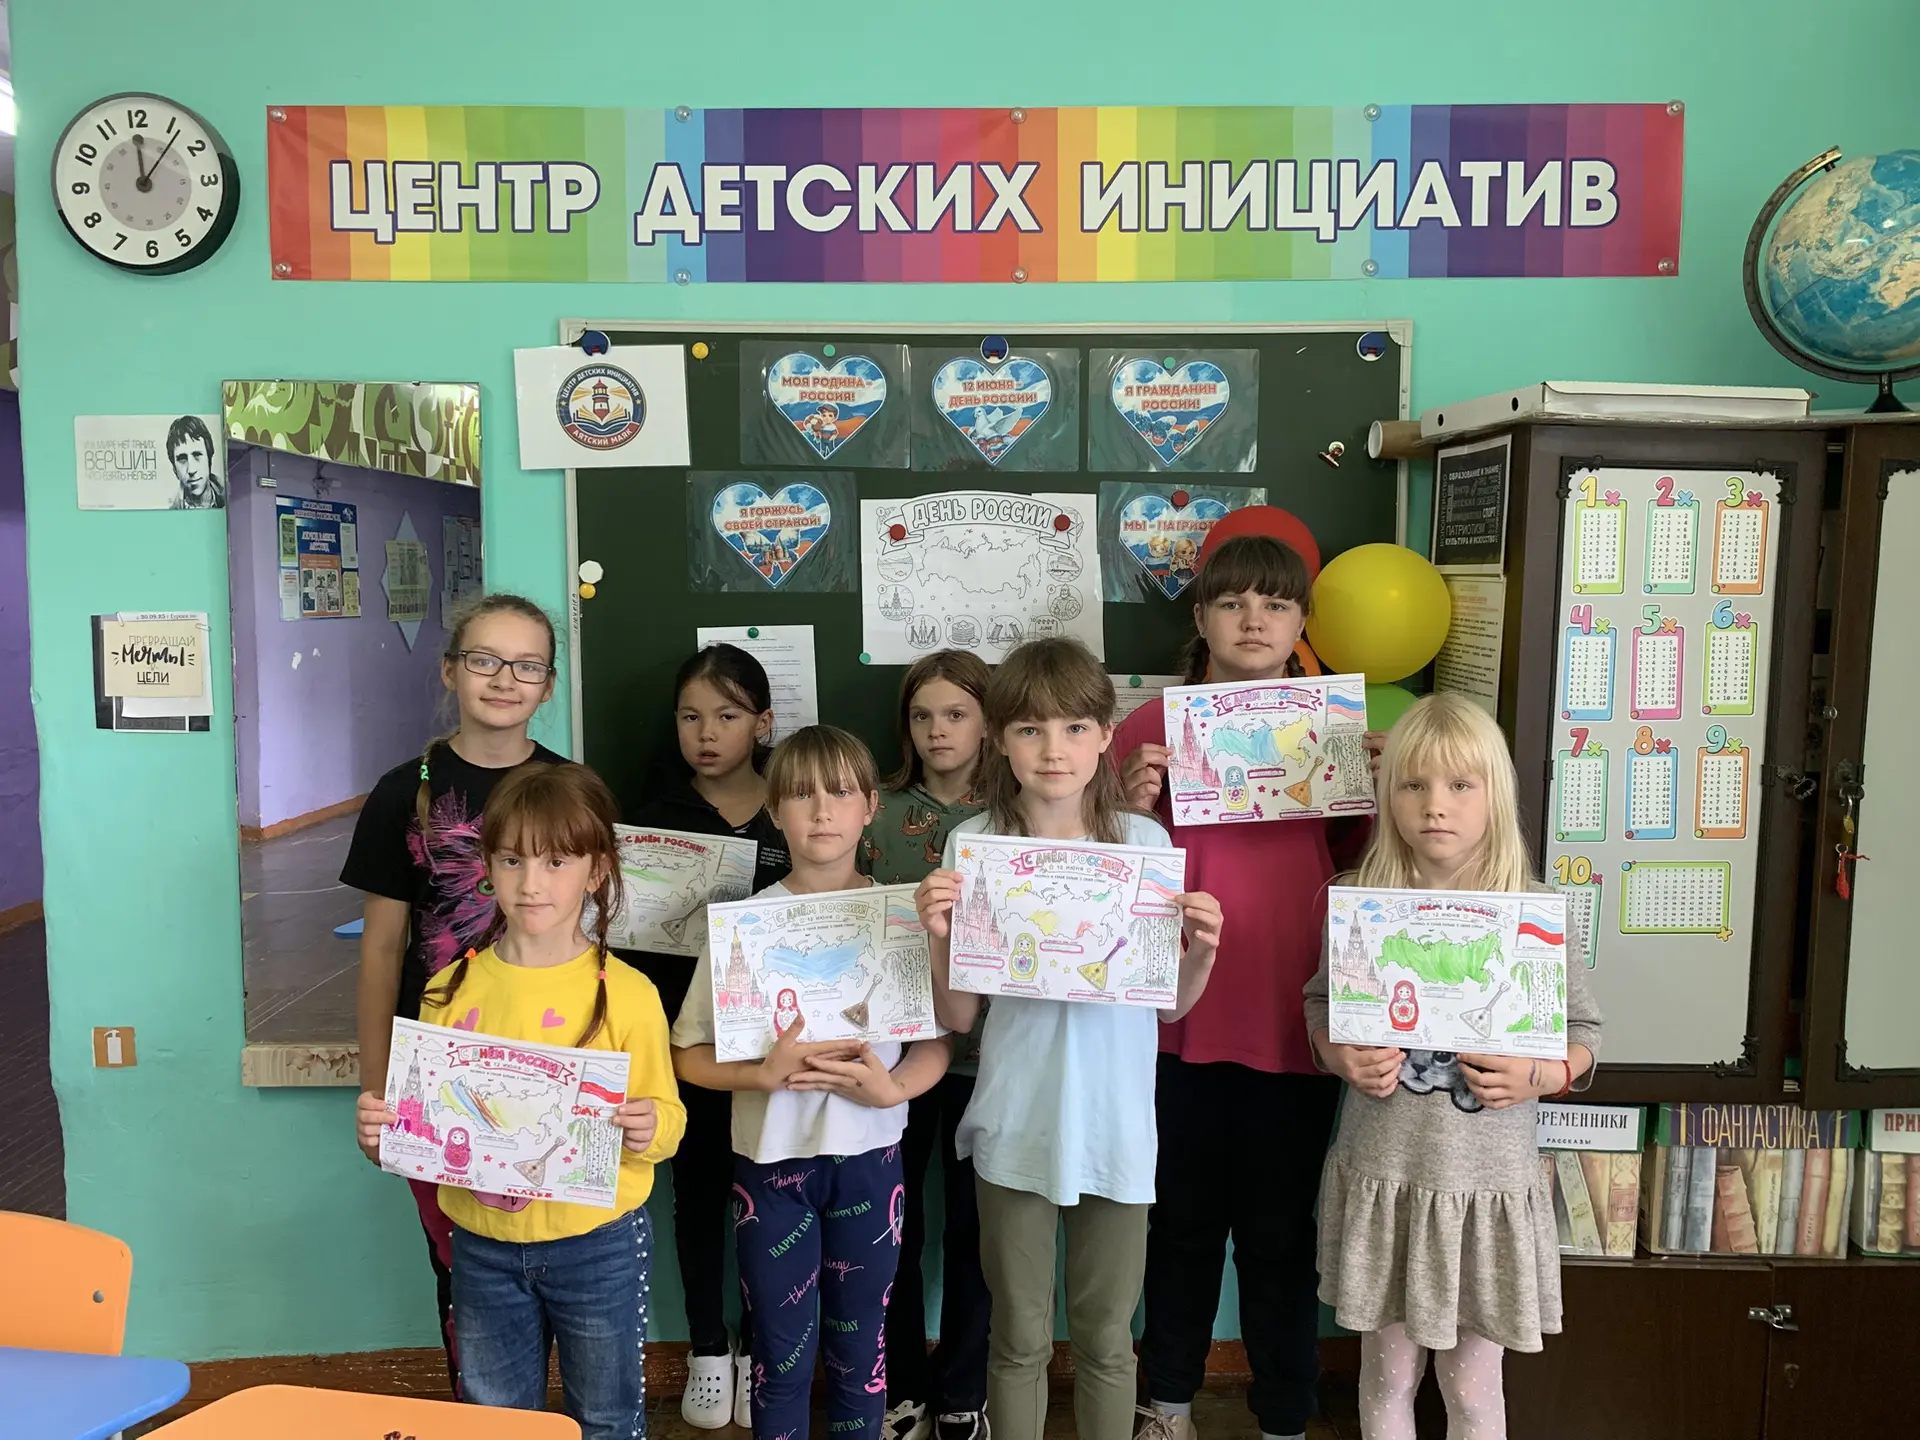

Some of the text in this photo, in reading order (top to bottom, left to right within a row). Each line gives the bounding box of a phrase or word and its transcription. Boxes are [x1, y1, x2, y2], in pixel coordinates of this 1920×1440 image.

[127, 109, 149, 128] 12
[166, 117, 176, 134] 1
[96, 118, 117, 141] 11
[75, 143, 97, 166] 10
[187, 139, 206, 157] 2
[72, 181, 90, 195] 9
[200, 174, 218, 187] 3
[329, 158, 1620, 248] ЦЕНТР ДЕТСКИХ ИНИЦИАТИВ
[84, 212, 102, 228] 8
[196, 206, 214, 222] 4
[113, 232, 128, 250] 7
[174, 228, 192, 247] 5
[146, 240, 159, 258] 6
[561, 368, 640, 398] ЦЕНТР ДЕТСКИХ ИНИЦИАТИВ
[781, 377, 865, 389] МОЯ РОДИНА
[962, 380, 1013, 392] 12 ИЮНЯ
[1124, 384, 1217, 396] Я ГРАЖДАНИН
[799, 391, 856, 401] РОССИЯ!
[948, 393, 1037, 408] ДЕНЬ РОССИИ!
[1141, 400, 1201, 411] РОССИИ!
[572, 428, 634, 446] АЯТСКИЙ МАЯК
[84, 450, 157, 470] ВЕРШИН
[1579, 475, 1597, 507] 1
[1655, 476, 1675, 507] 2
[1724, 476, 1744, 507] 3
[740, 505, 804, 518] Я ГОРЖУСЬ
[912, 498, 1052, 528] ДЕНЬ РОССИИ
[723, 515, 821, 531] СВОЕЙ СТРАНОЙ!
[1123, 520, 1148, 531] МЫ
[1570, 604, 1592, 635] 4
[1640, 604, 1661, 635] 5
[1711, 599, 1734, 629] 6
[129, 635, 196, 647] ПРЕВРАЩАЙ
[137, 671, 169, 684] ЦЕЛИ
[1224, 697, 1231, 707] С
[1234, 691, 1261, 705] ДНЁМ
[1569, 727, 1589, 757] 7
[1633, 725, 1655, 755] 8
[1706, 724, 1727, 754] 9
[634, 834, 661, 844] ДНЁМ
[1025, 854, 1033, 865] С
[1035, 849, 1067, 865] ДНЁМ
[1552, 855, 1592, 885] 10
[775, 911, 784, 922] С
[787, 903, 816, 920] ДНЁМ
[1399, 902, 1407, 914] С
[1410, 898, 1442, 913] ДНЁМ
[460, 1049, 468, 1059] С
[472, 1045, 505, 1060] ДНЁМ
[1702, 1104, 1820, 1149] ФАНТАСТИКА
[853, 1200, 872, 1216] DAY
[768, 1210, 815, 1258] HAPPY DAY
[840, 1319, 859, 1332] DAY
[777, 1320, 814, 1375] HAPPY DAY
[847, 1417, 866, 1431] DAY
